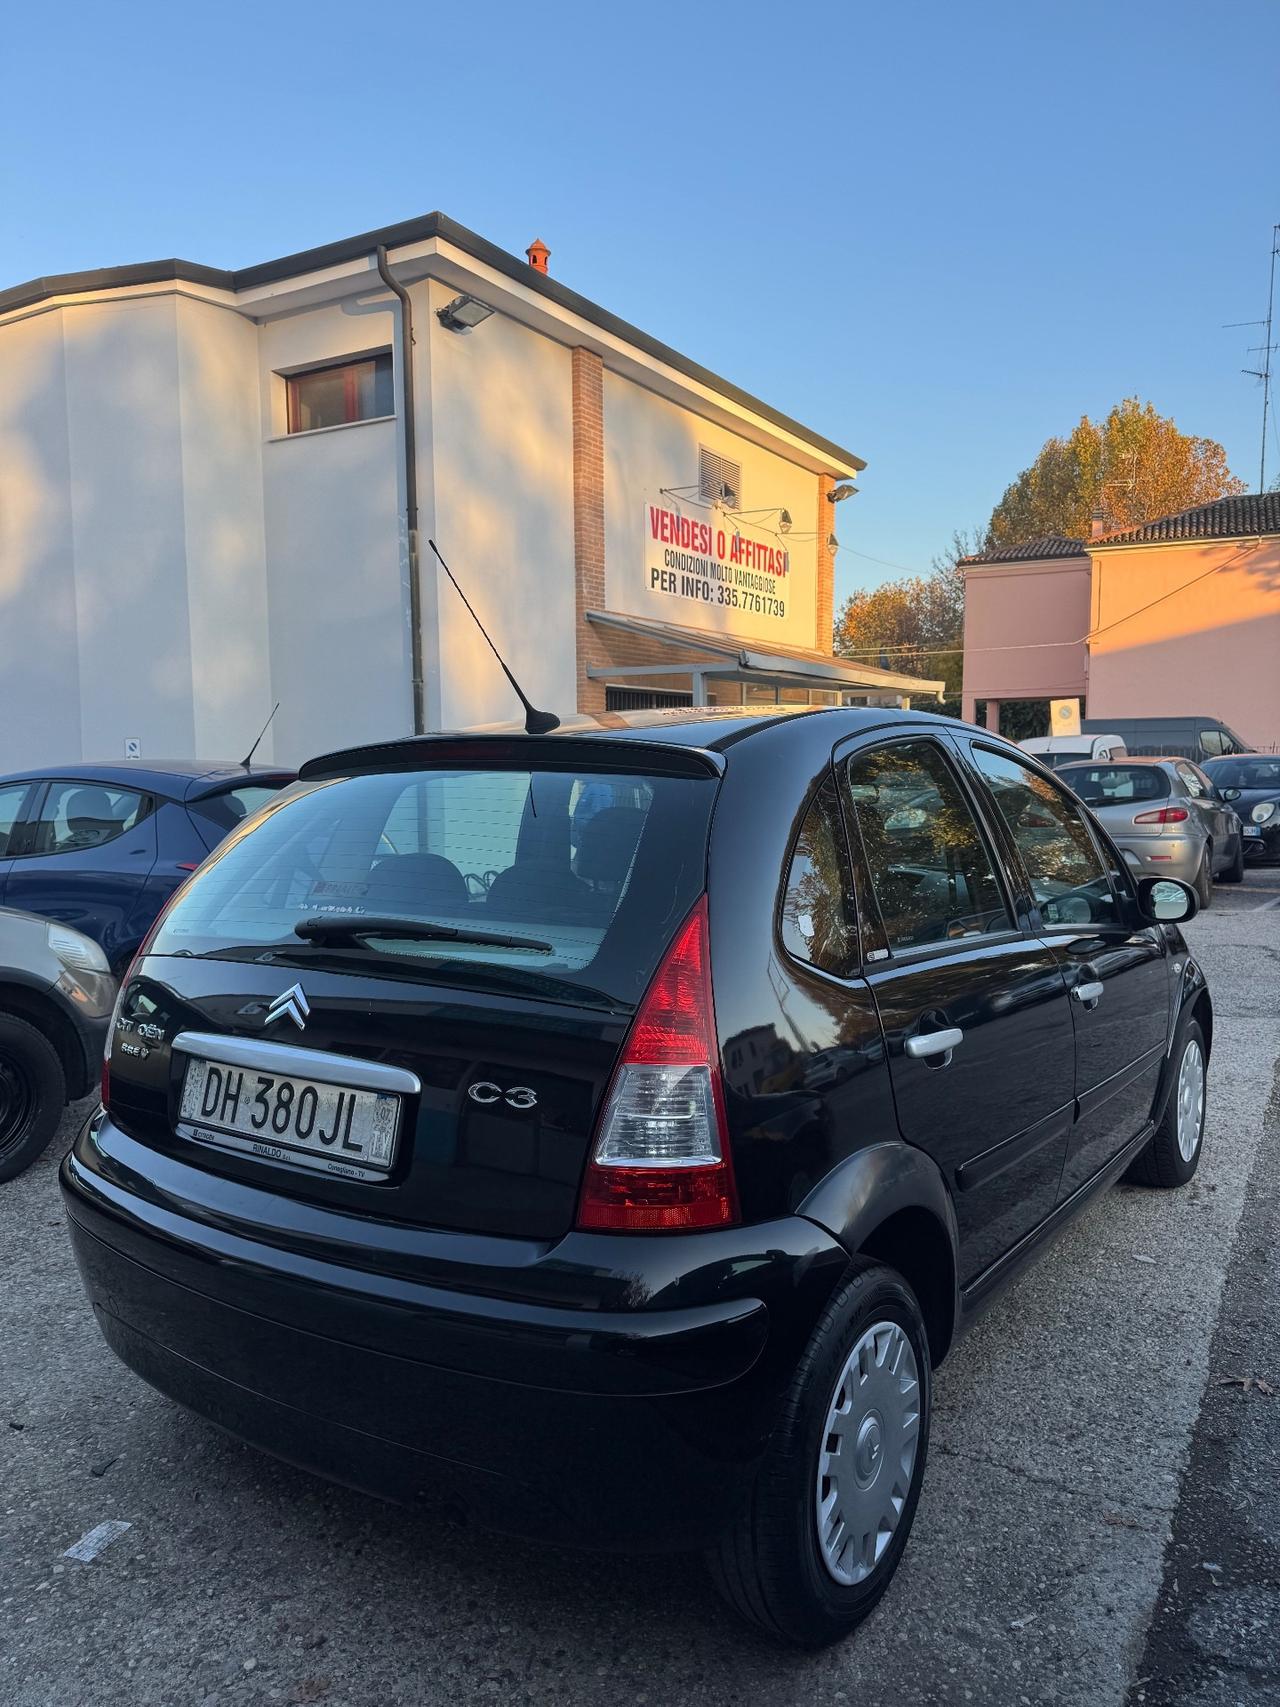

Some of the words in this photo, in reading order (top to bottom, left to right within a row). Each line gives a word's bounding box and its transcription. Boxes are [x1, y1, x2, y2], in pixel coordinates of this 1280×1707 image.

[650, 506, 712, 556] VENDESI
[717, 530, 725, 559] O
[730, 534, 787, 578] AFFITTASI
[651, 567, 677, 594] PER
[681, 576, 714, 602] INFO:
[717, 585, 785, 618] 335.7761739
[664, 548, 708, 578] CONDIZIONI
[710, 561, 733, 584] MOLTO
[734, 568, 776, 595] VANTAGGIOSE
[200, 1066, 244, 1124] DH
[468, 1081, 537, 1109] C3
[252, 1143, 282, 1158] RINALDO
